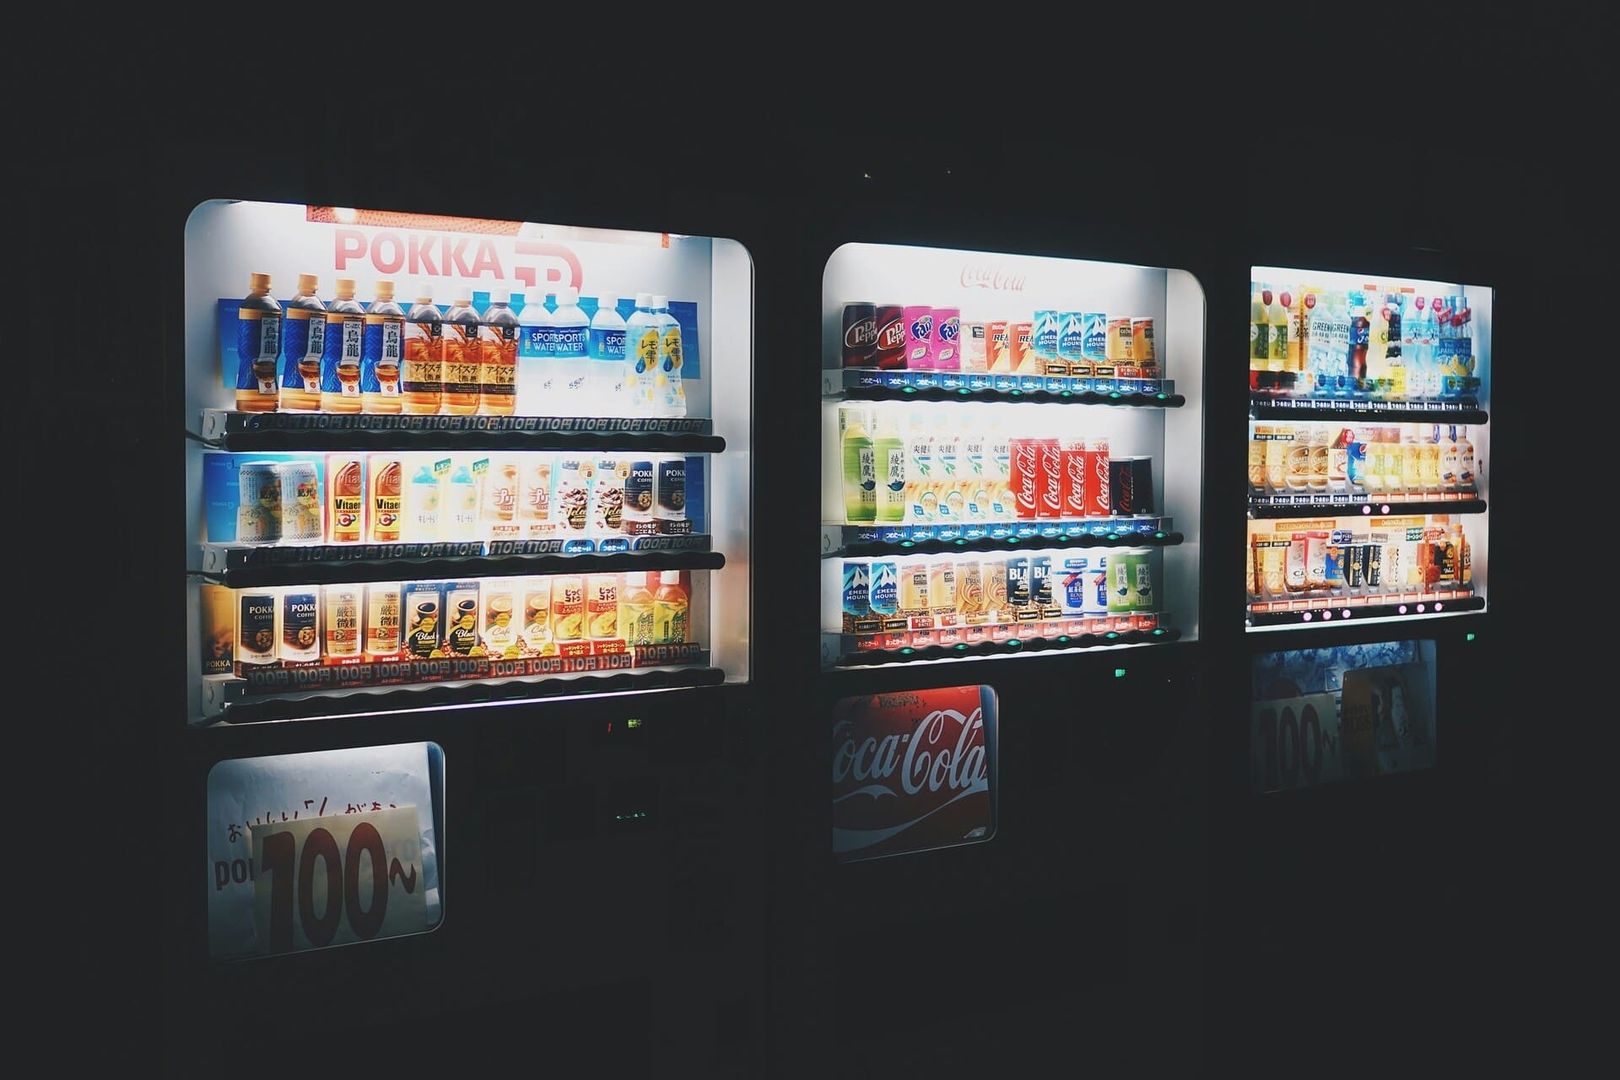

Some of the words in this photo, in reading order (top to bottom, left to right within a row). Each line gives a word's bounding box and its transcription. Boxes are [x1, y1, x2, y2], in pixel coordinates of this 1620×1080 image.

[335, 229, 504, 280] POKKA
[264, 326, 277, 354] 烏龍
[311, 326, 322, 354] 烏龍
[346, 330, 359, 357] 烏龍
[386, 331, 398, 357] 烏龍
[555, 334, 586, 343] SPORTS
[556, 343, 584, 352] WATER
[387, 415, 422, 429] 110円
[426, 416, 461, 429] 110円
[465, 416, 498, 429] 110円
[502, 417, 536, 429] 110円
[539, 418, 571, 430] 110円
[575, 418, 606, 430] 110円
[610, 419, 641, 431] 110円
[491, 541, 525, 555] 110円
[527, 541, 561, 554] 110円
[640, 537, 669, 551] 100円
[637, 646, 668, 660] 110円
[670, 644, 700, 658] 110円
[415, 661, 450, 676] 100円
[454, 659, 489, 674] 100円
[492, 660, 526, 676] 100円
[528, 658, 560, 674] 100円
[564, 657, 596, 672] 110円
[599, 654, 631, 670] 110円
[293, 668, 330, 684] 100円
[334, 666, 371, 681] 100円
[375, 664, 411, 678] 100円
